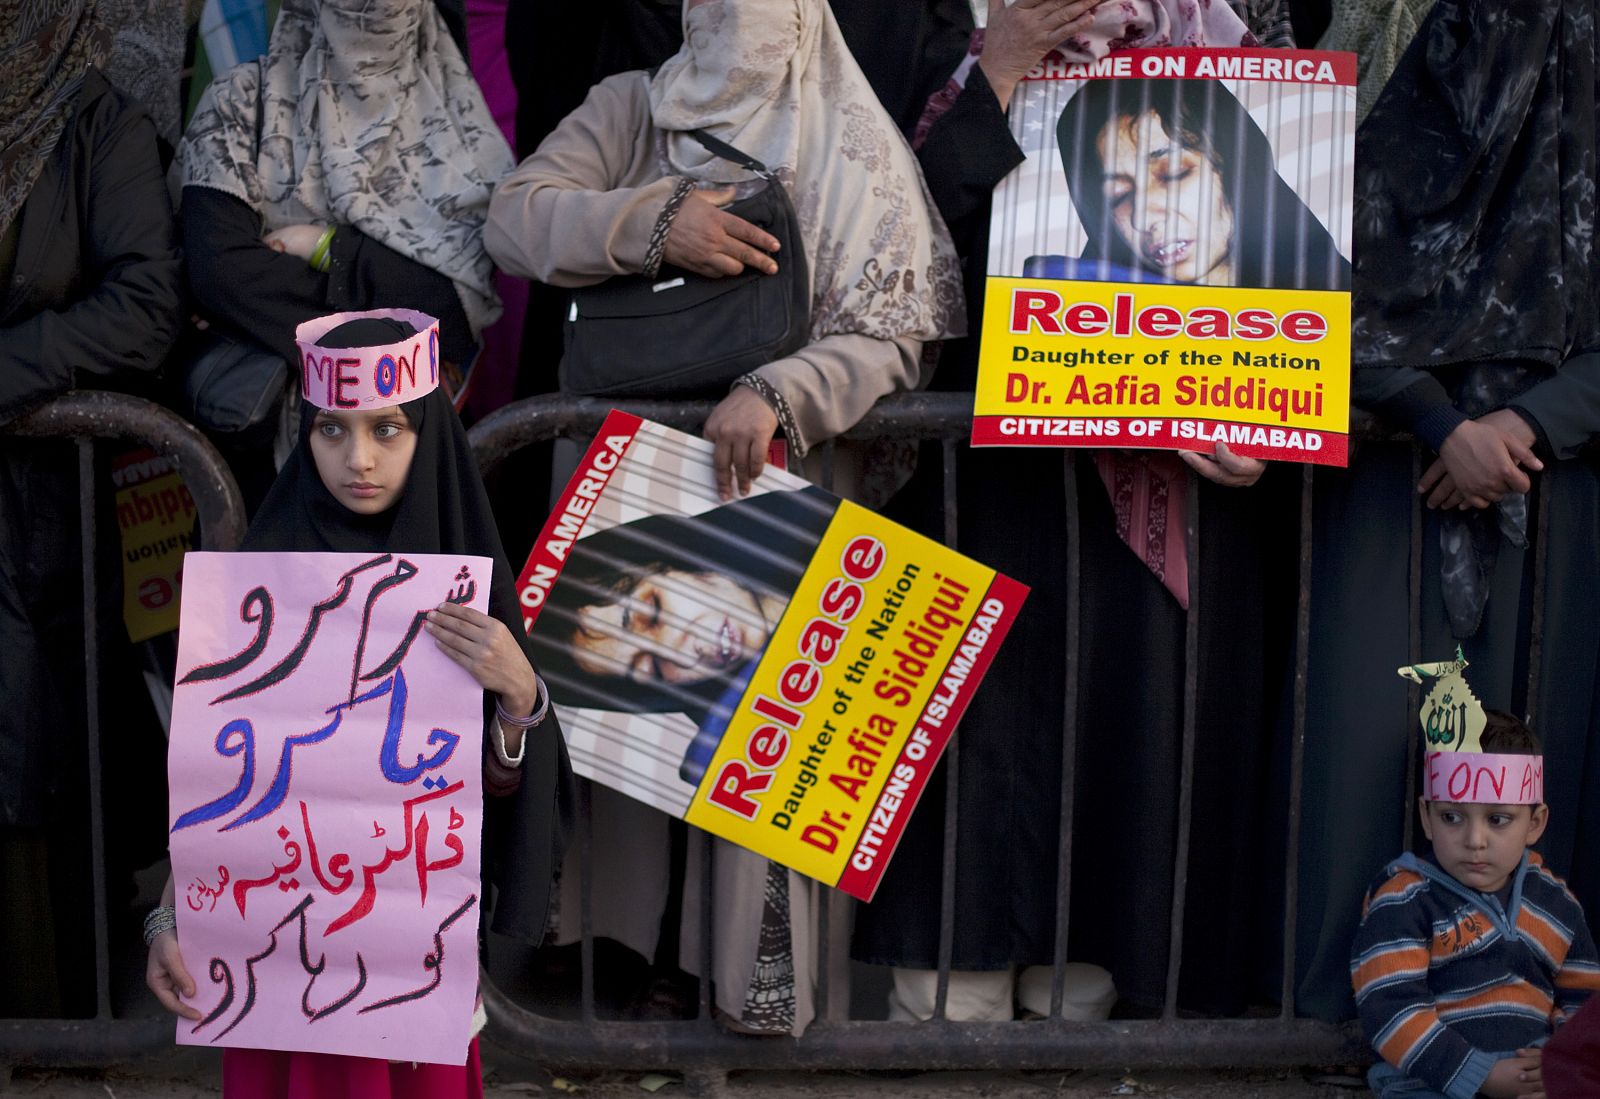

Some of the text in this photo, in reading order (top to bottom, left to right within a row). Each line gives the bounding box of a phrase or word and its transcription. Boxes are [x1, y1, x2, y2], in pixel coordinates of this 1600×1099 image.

[1141, 56, 1186, 78] ON
[1194, 56, 1337, 83] AMERICA
[1008, 287, 1329, 343] Release
[374, 343, 420, 398] ON
[1012, 346, 1320, 371] Daughter of the Nation
[1005, 372, 1324, 423] Dr. Aafia Siddiqui
[999, 417, 1323, 452] CITIZENS OF ISLAMABAD
[520, 433, 631, 607] ON AMERICA
[706, 534, 887, 821] Release
[771, 562, 921, 831] Daughter of the Nation
[800, 573, 970, 855] Dr. Aafia Siddiqui
[851, 598, 1004, 871] CITIZENS OF ISLAMABAD
[1447, 761, 1507, 801] ON
